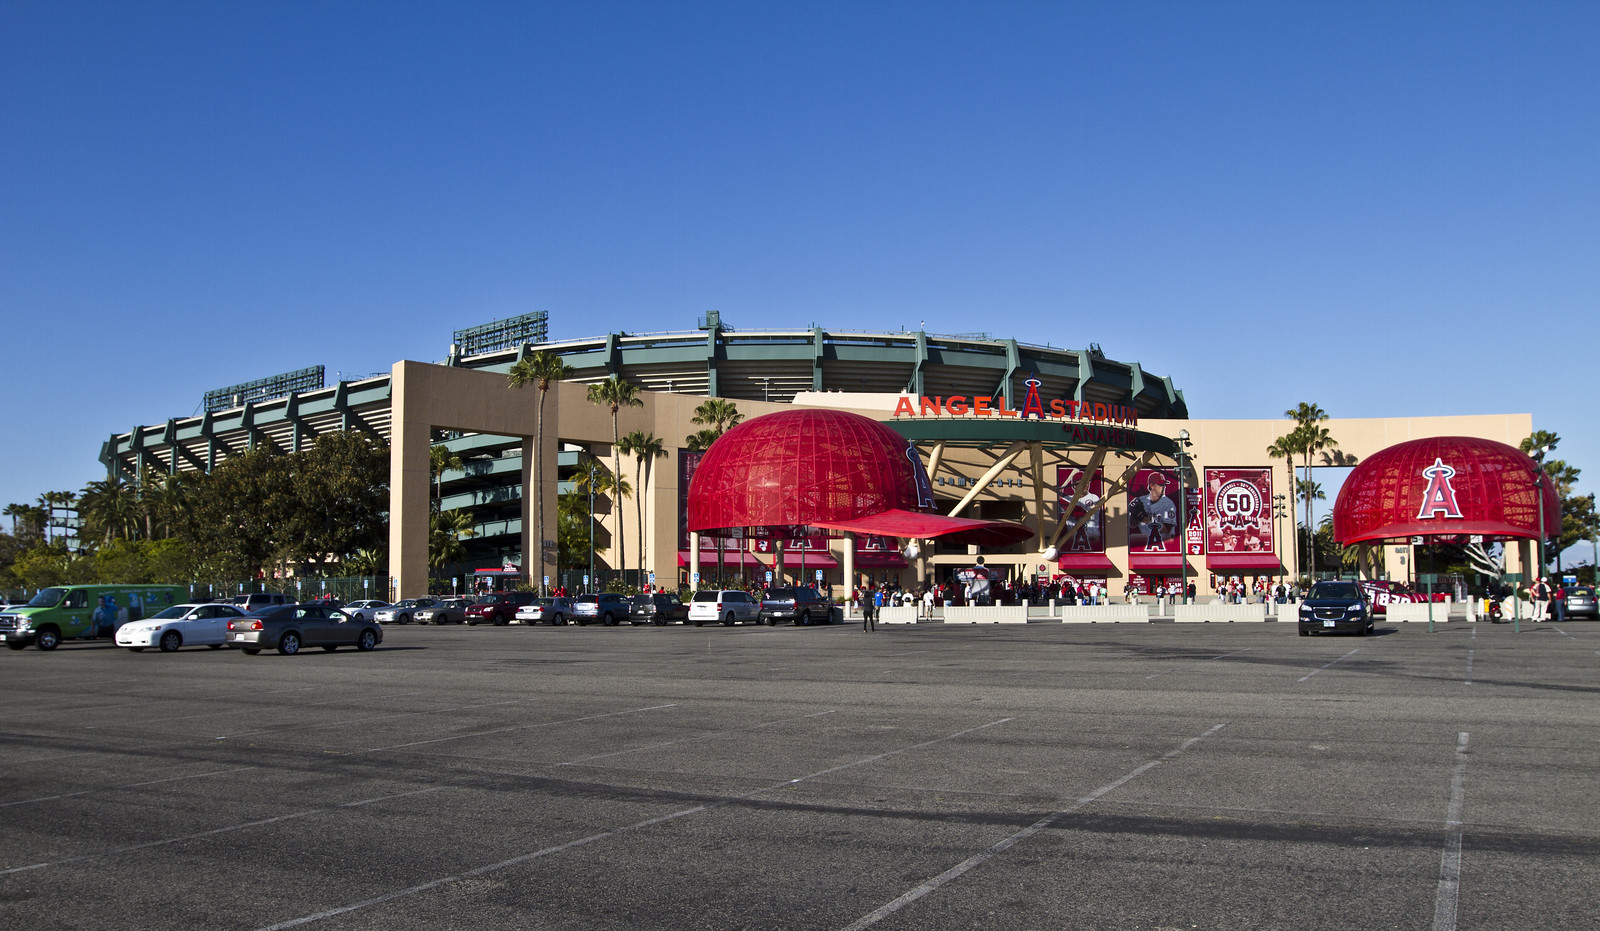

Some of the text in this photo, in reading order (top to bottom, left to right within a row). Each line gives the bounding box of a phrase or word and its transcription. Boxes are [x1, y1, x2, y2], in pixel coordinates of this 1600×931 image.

[893, 395, 1017, 417] ANGEL
[1050, 399, 1138, 427] STADIUM
[1072, 425, 1137, 446] ANAHEIM
[938, 477, 1022, 488] HOME ATE
[1416, 457, 1464, 519] A
[1226, 493, 1251, 512] 50
